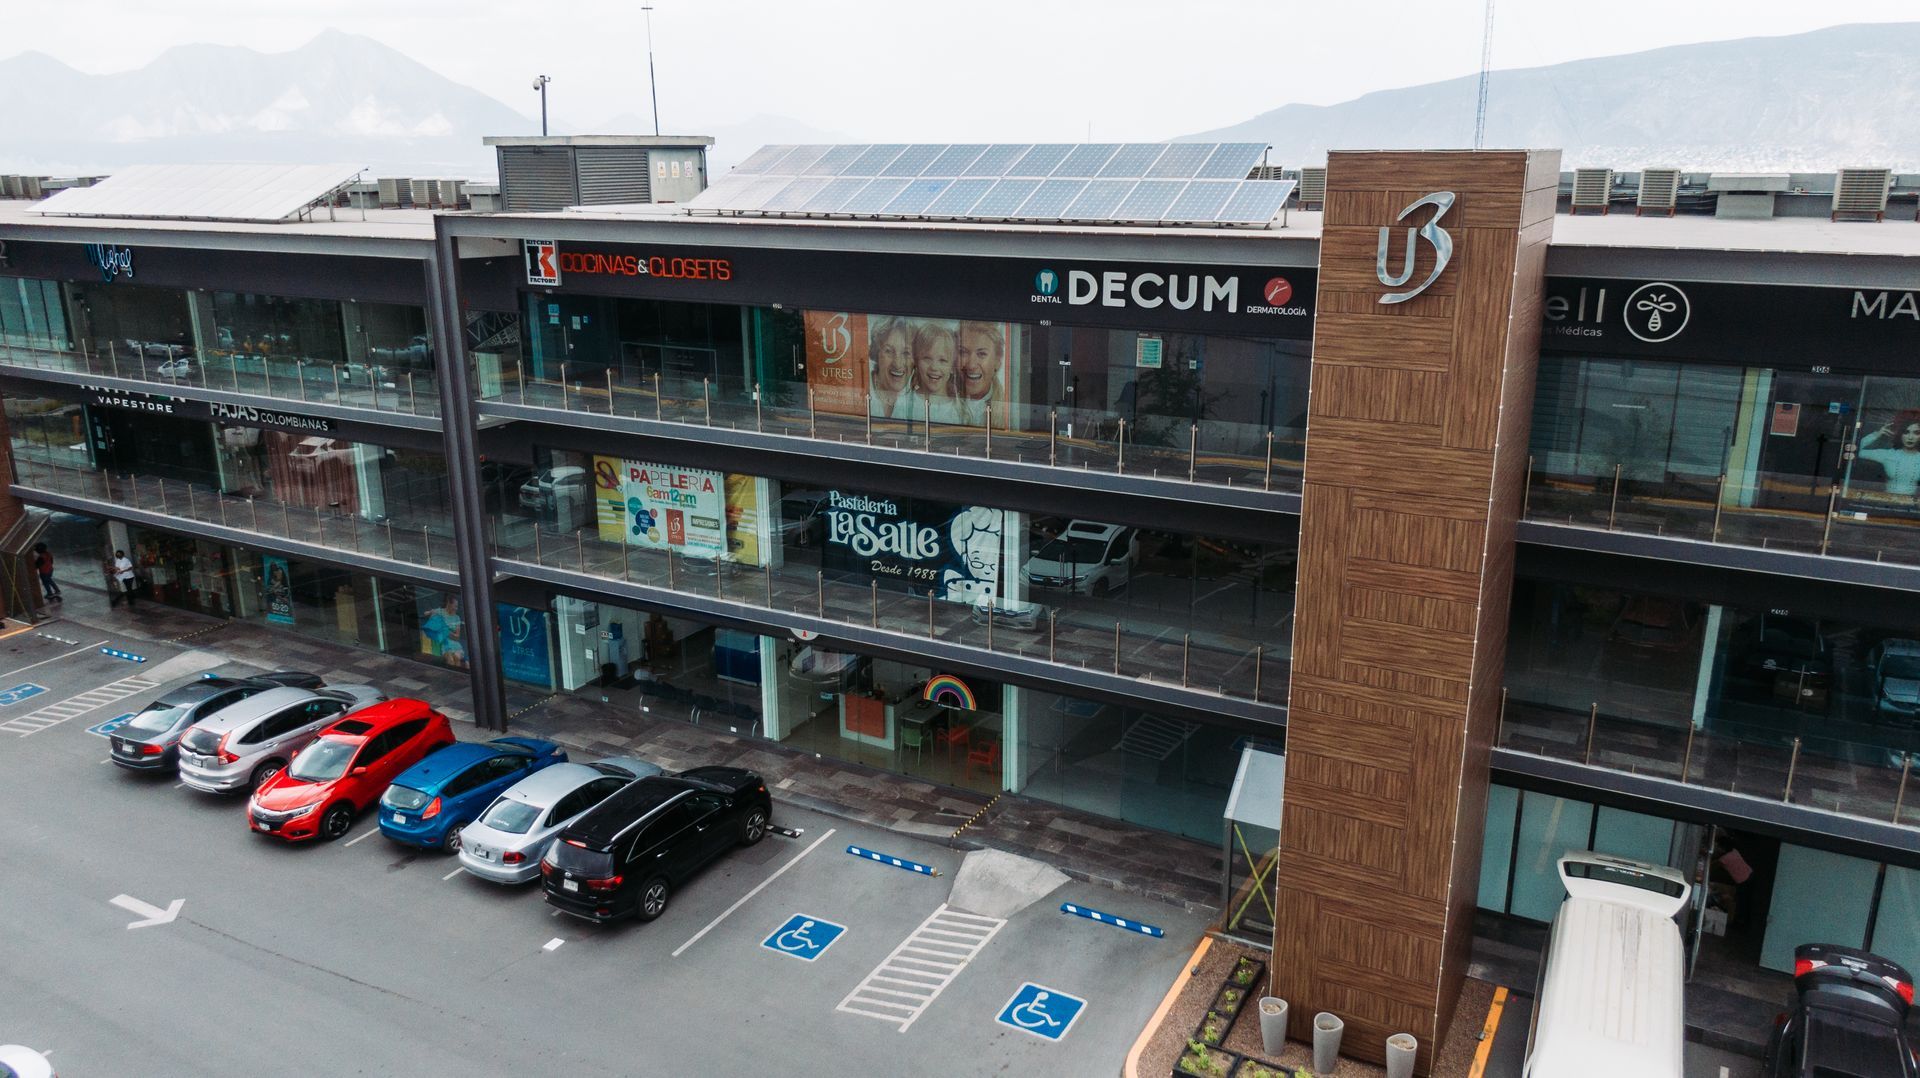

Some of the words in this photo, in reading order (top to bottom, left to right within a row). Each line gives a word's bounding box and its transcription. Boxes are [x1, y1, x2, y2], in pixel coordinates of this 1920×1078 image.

[1031, 294, 1062, 304] DENTAL
[1068, 270, 1239, 314] DECUM
[1246, 304, 1307, 317] DERMATOLOGÍA
[1555, 325, 1603, 337] Médicas
[822, 366, 854, 380] UTRES
[98, 396, 173, 413] VAPESTORE
[210, 401, 259, 421] FAJAS
[260, 412, 329, 432] COLOMBIANAS
[829, 490, 898, 516] Pastelería
[871, 560, 902, 576] Desde
[906, 566, 937, 581] 1988
